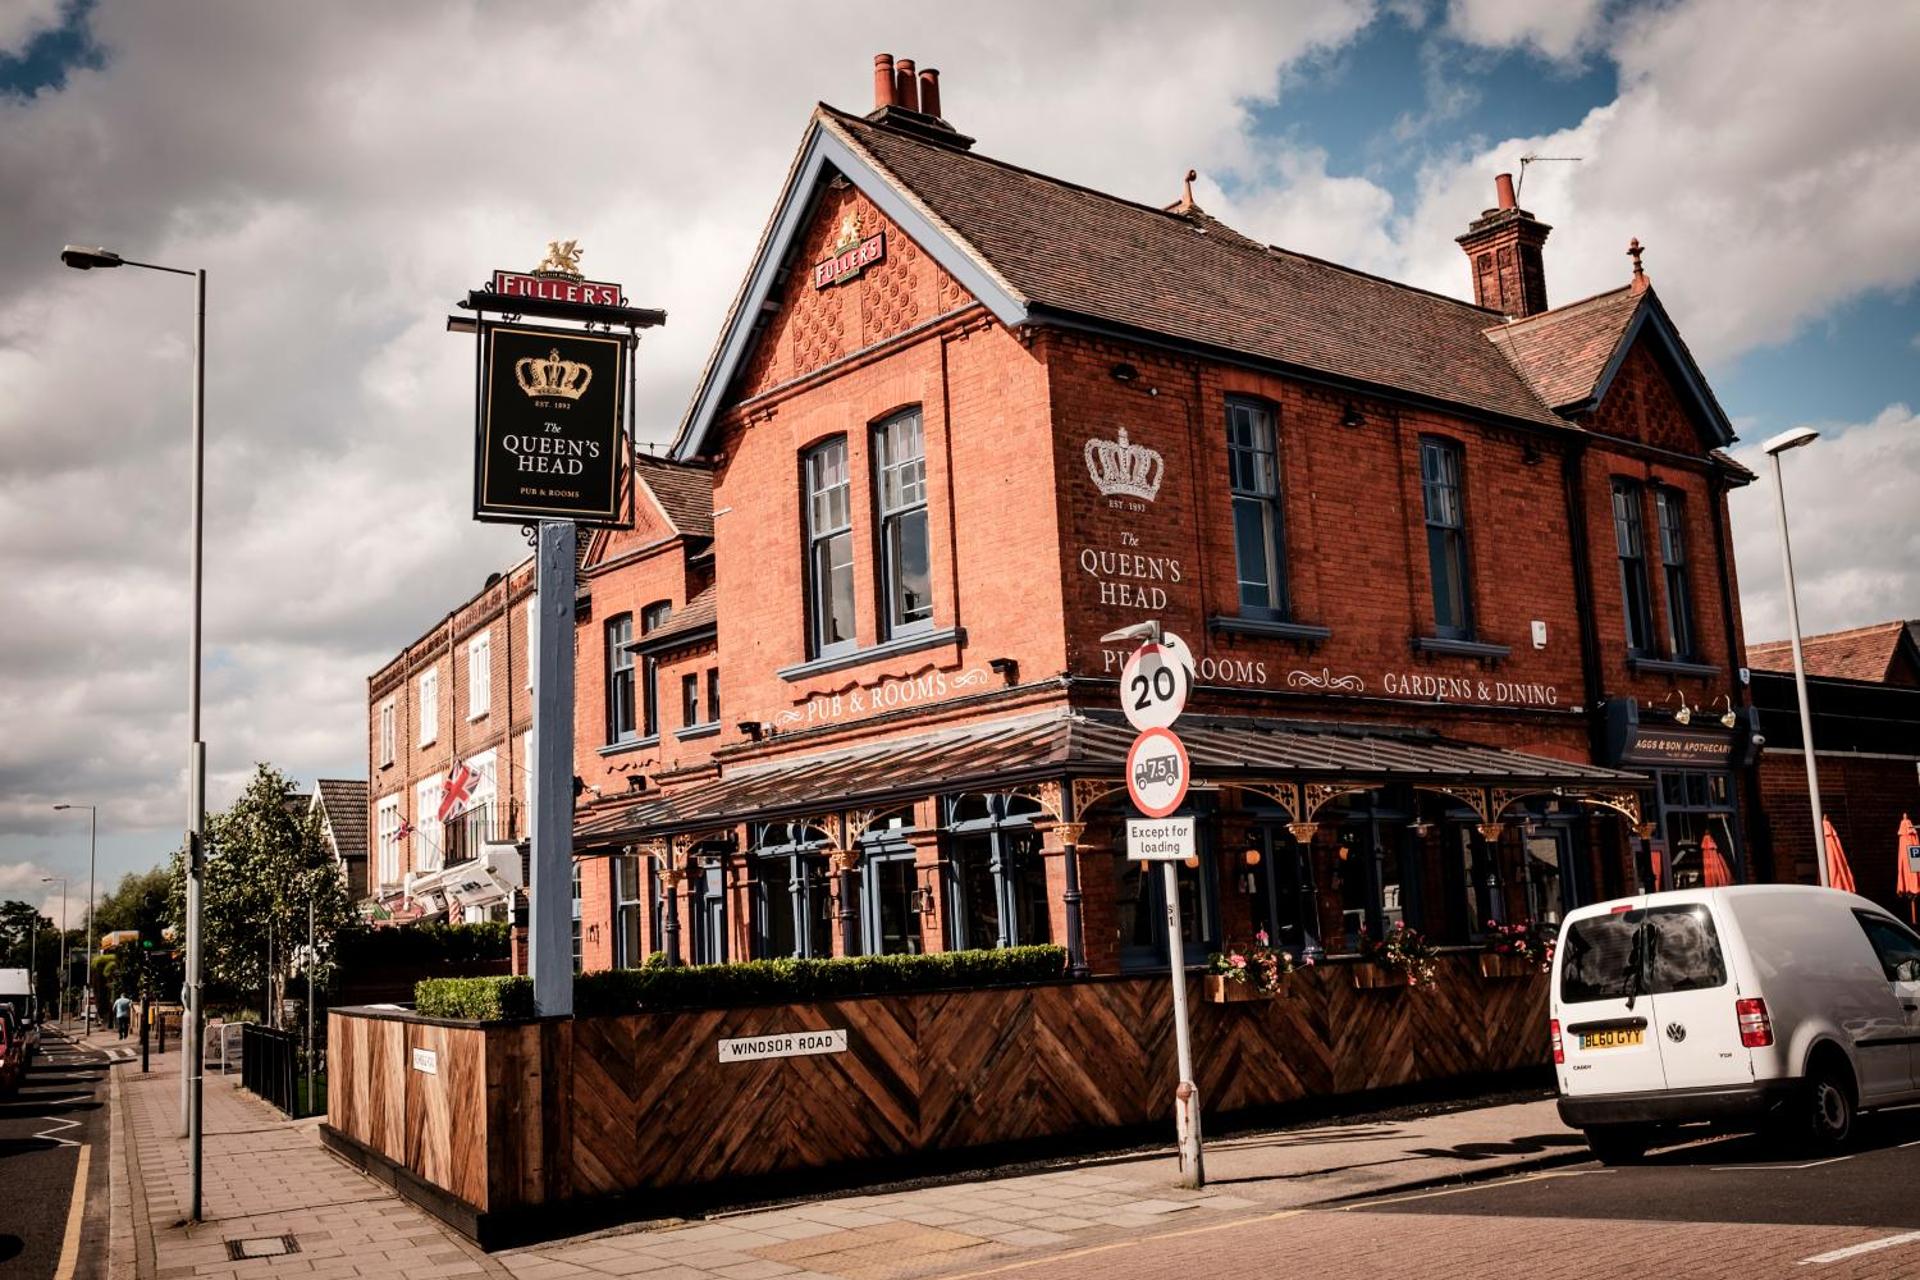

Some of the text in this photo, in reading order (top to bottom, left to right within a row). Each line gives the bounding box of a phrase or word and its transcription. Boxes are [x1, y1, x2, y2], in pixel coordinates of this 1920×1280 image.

[503, 275, 612, 306] FULLER'S
[544, 422, 562, 434] The
[502, 434, 600, 458] QUEEN'S
[517, 455, 584, 476] HEAD
[520, 487, 537, 495] PUB
[548, 489, 580, 499] ROOMS
[1121, 531, 1140, 546] The
[1080, 548, 1181, 583] QUEEN'S
[1099, 581, 1168, 611] HEAD
[807, 672, 948, 722] PUB & ROOMS
[1130, 666, 1176, 711] 20
[1383, 672, 1558, 706] GARDENS & DINING
[1658, 740, 1665, 750] &
[1666, 741, 1682, 751] SON
[1683, 742, 1732, 753] APOTHECARY
[1131, 824, 1188, 839] Except for
[1140, 841, 1180, 855] loading
[731, 1036, 833, 1055] WINDSOR ROAD
